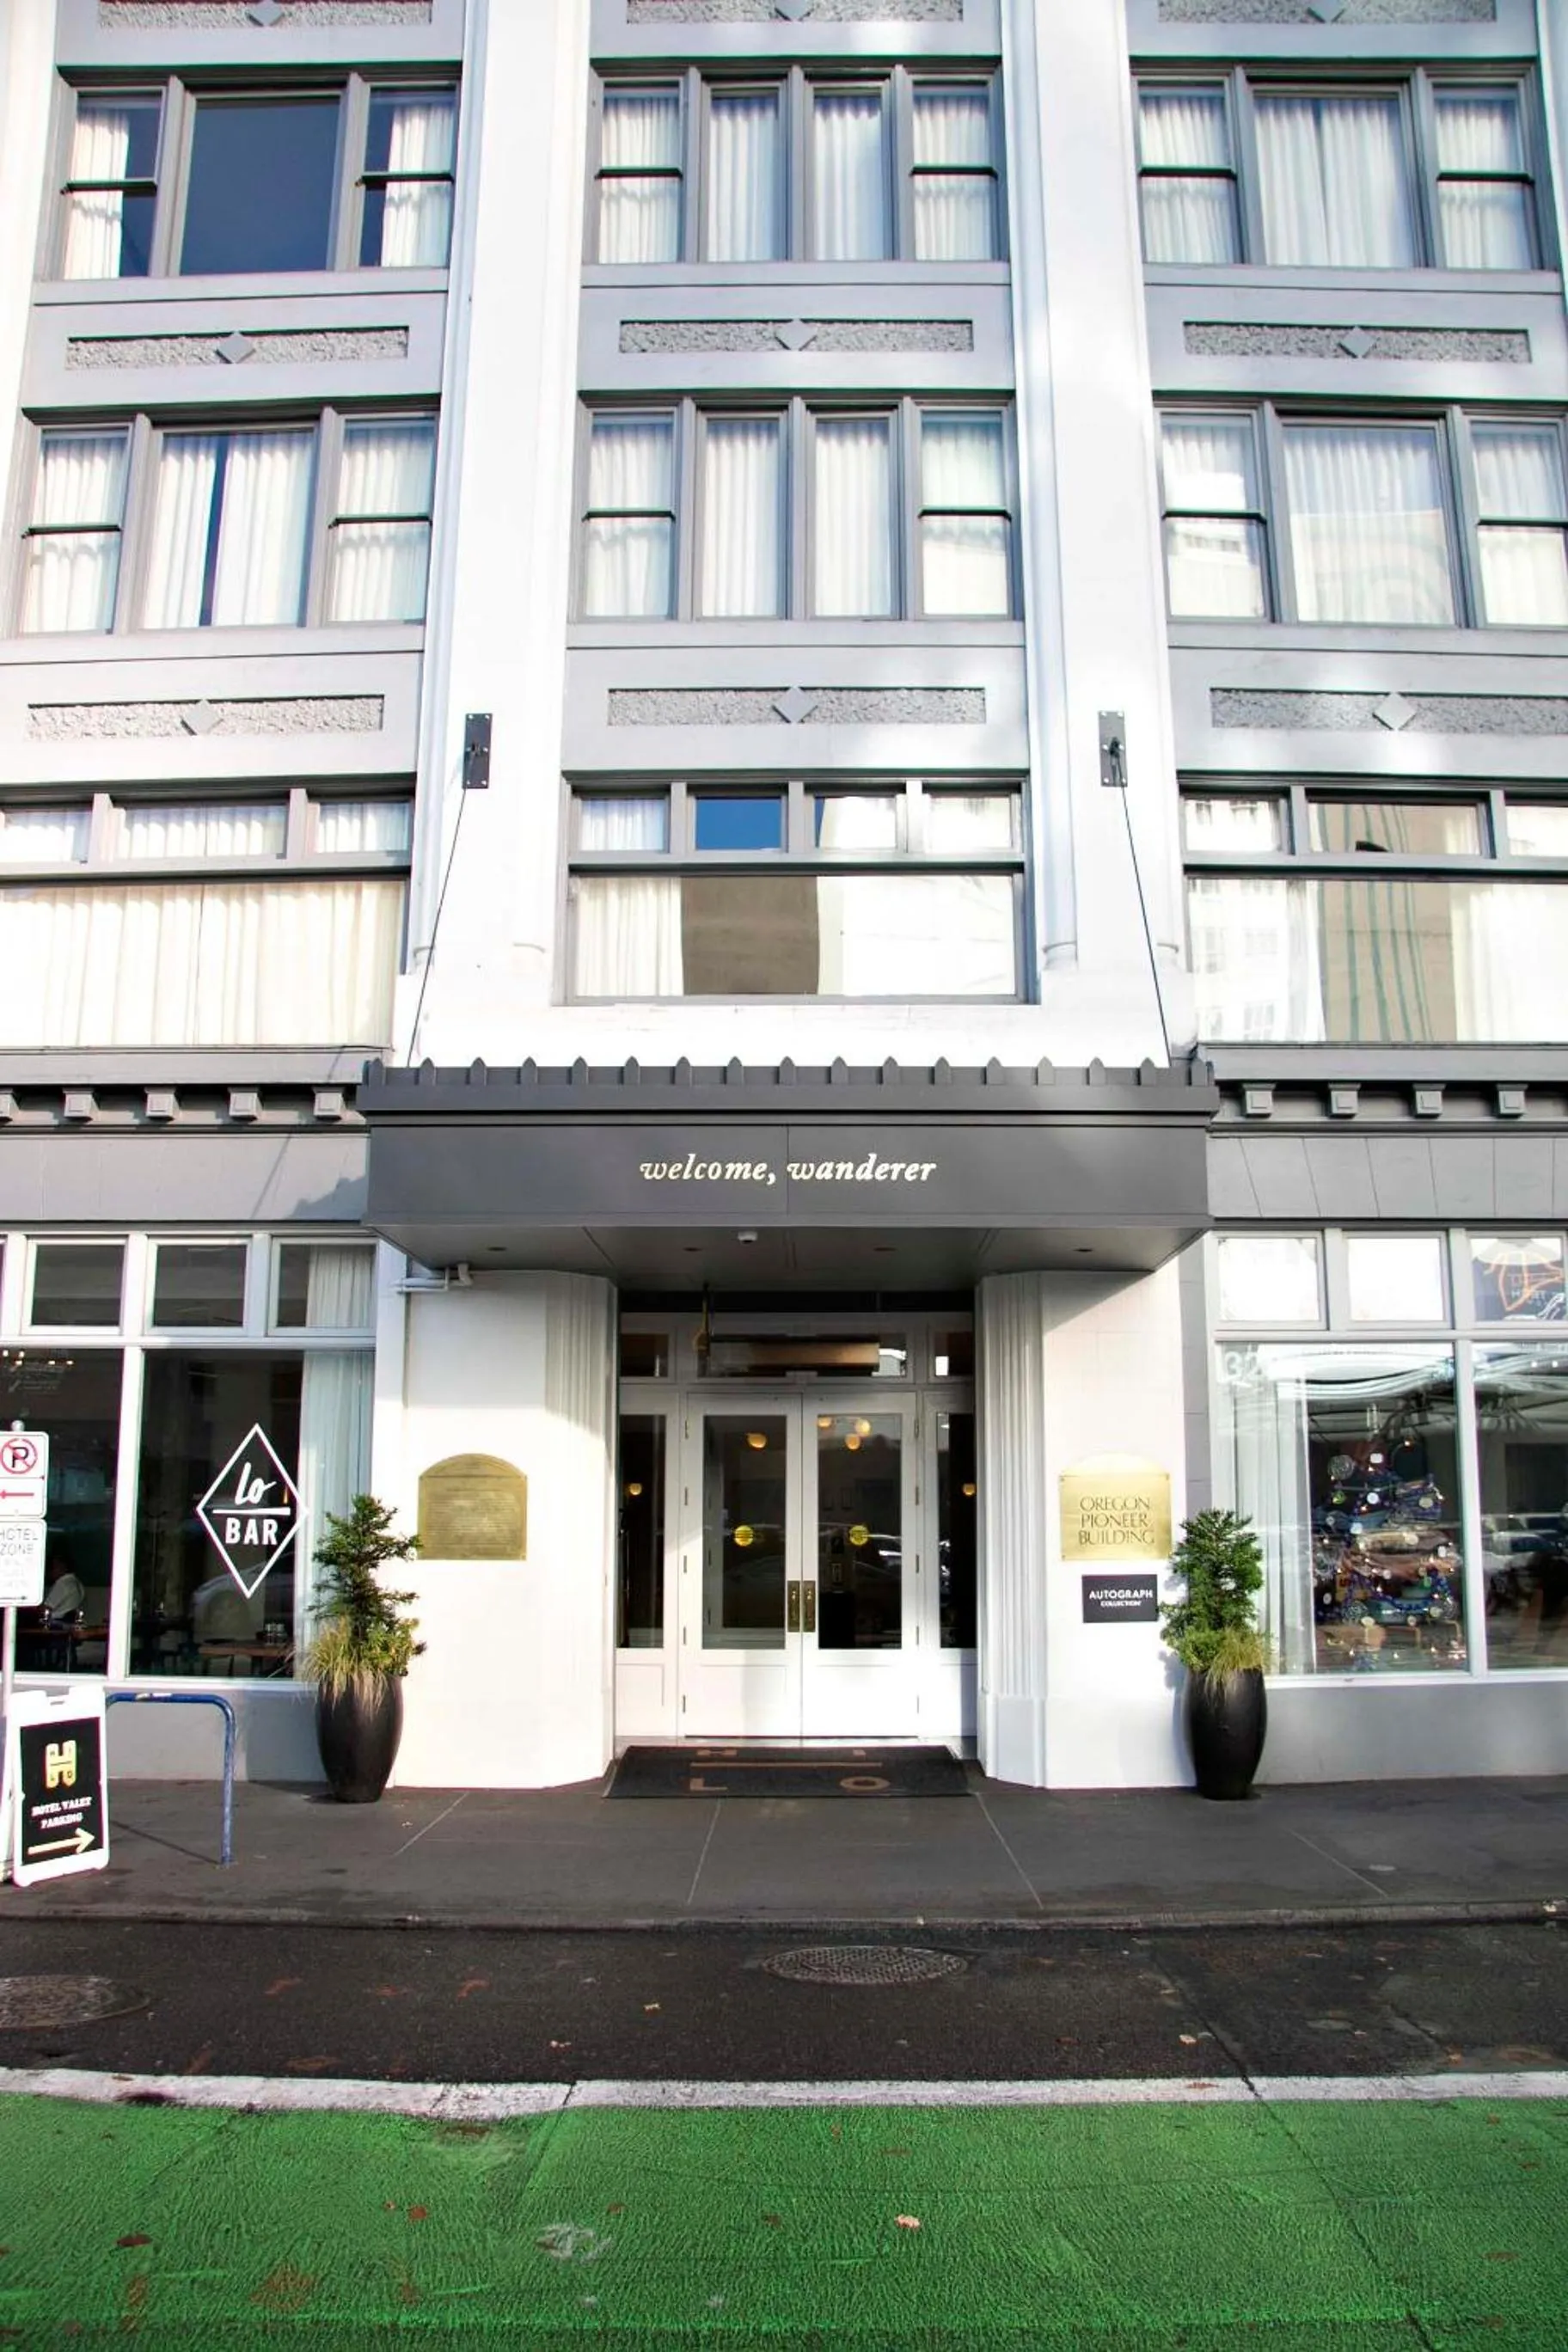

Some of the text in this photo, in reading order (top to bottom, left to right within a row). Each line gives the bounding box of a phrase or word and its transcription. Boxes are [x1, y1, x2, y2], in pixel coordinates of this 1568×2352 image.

[640, 1153, 937, 1185] welcome, wanderer
[1080, 1496, 1150, 1511] OREGON
[1081, 1513, 1148, 1528] PIONEER
[225, 1517, 279, 1545] BAR
[1078, 1529, 1155, 1546] BUILDING
[1088, 1589, 1154, 1600] AUTOGRAPH
[31, 1797, 92, 1817] HOTEL VALET
[40, 1812, 83, 1829] PARKING
